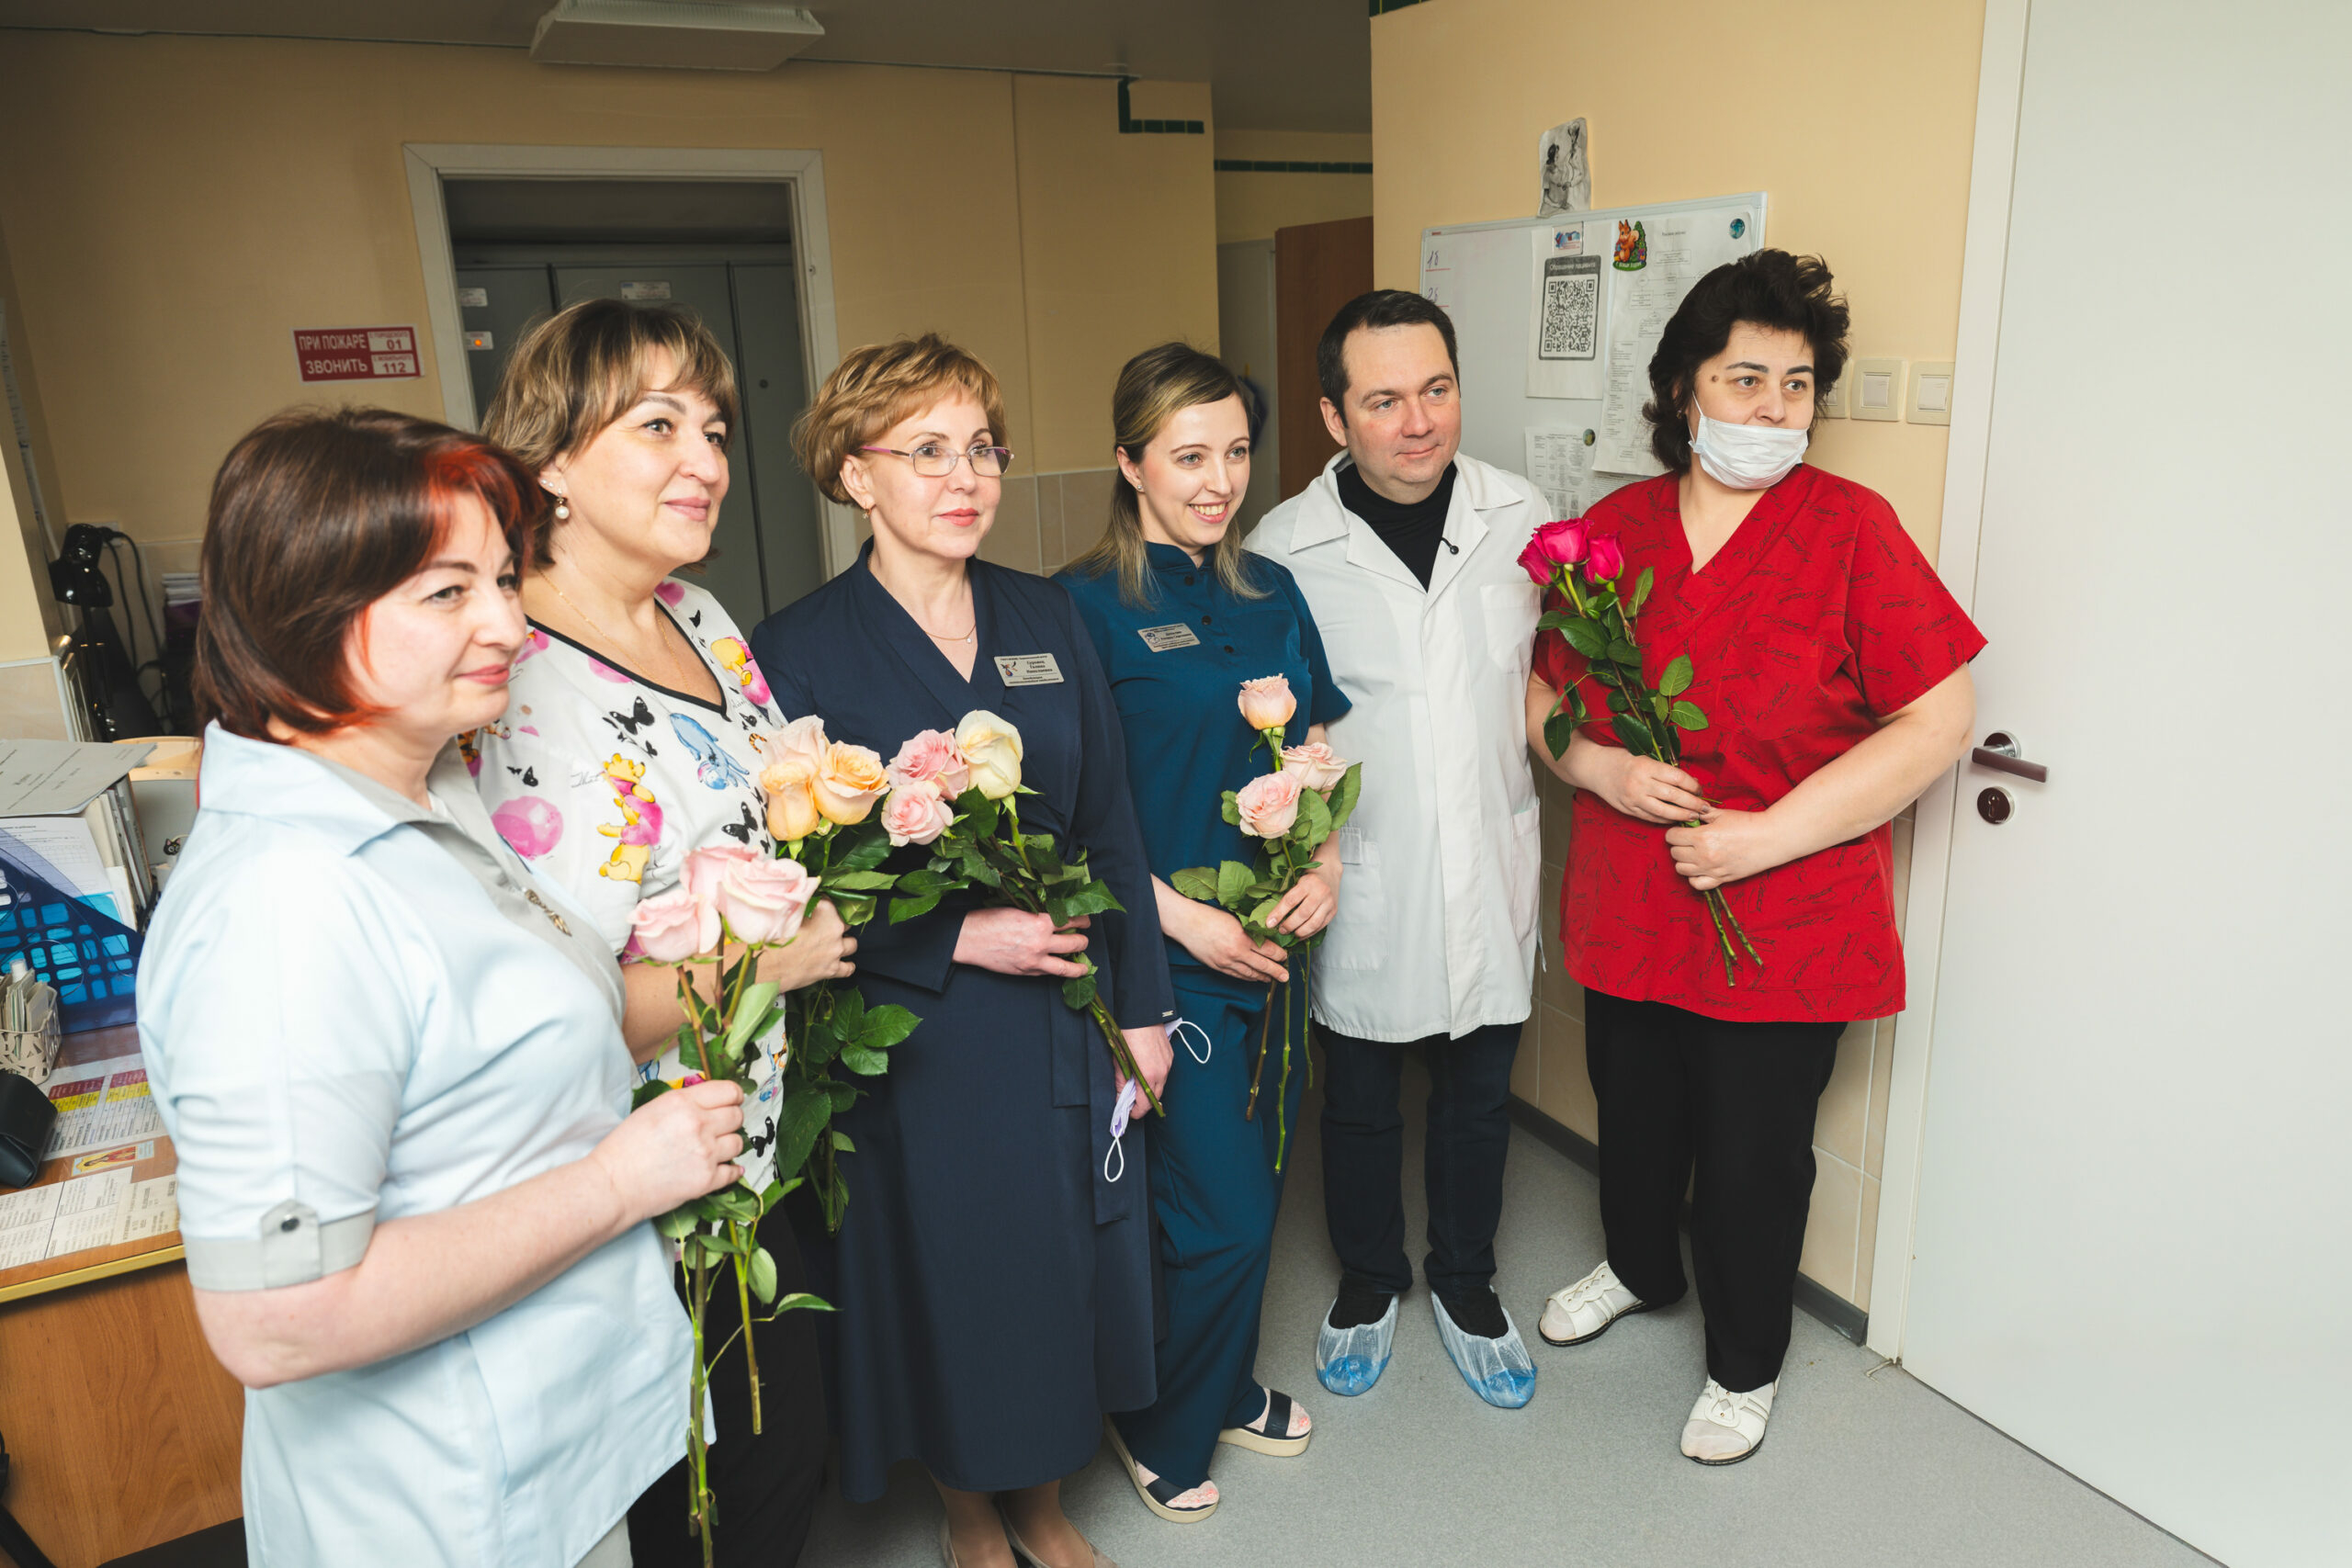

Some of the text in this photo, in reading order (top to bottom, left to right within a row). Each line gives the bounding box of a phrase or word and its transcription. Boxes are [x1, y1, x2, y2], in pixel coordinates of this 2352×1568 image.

[299, 333, 367, 351] ПРИ ПОЖАРЕ
[387, 338, 402, 350] 01
[306, 358, 368, 374] ЗВОНИТЬ
[382, 361, 406, 373] 112
